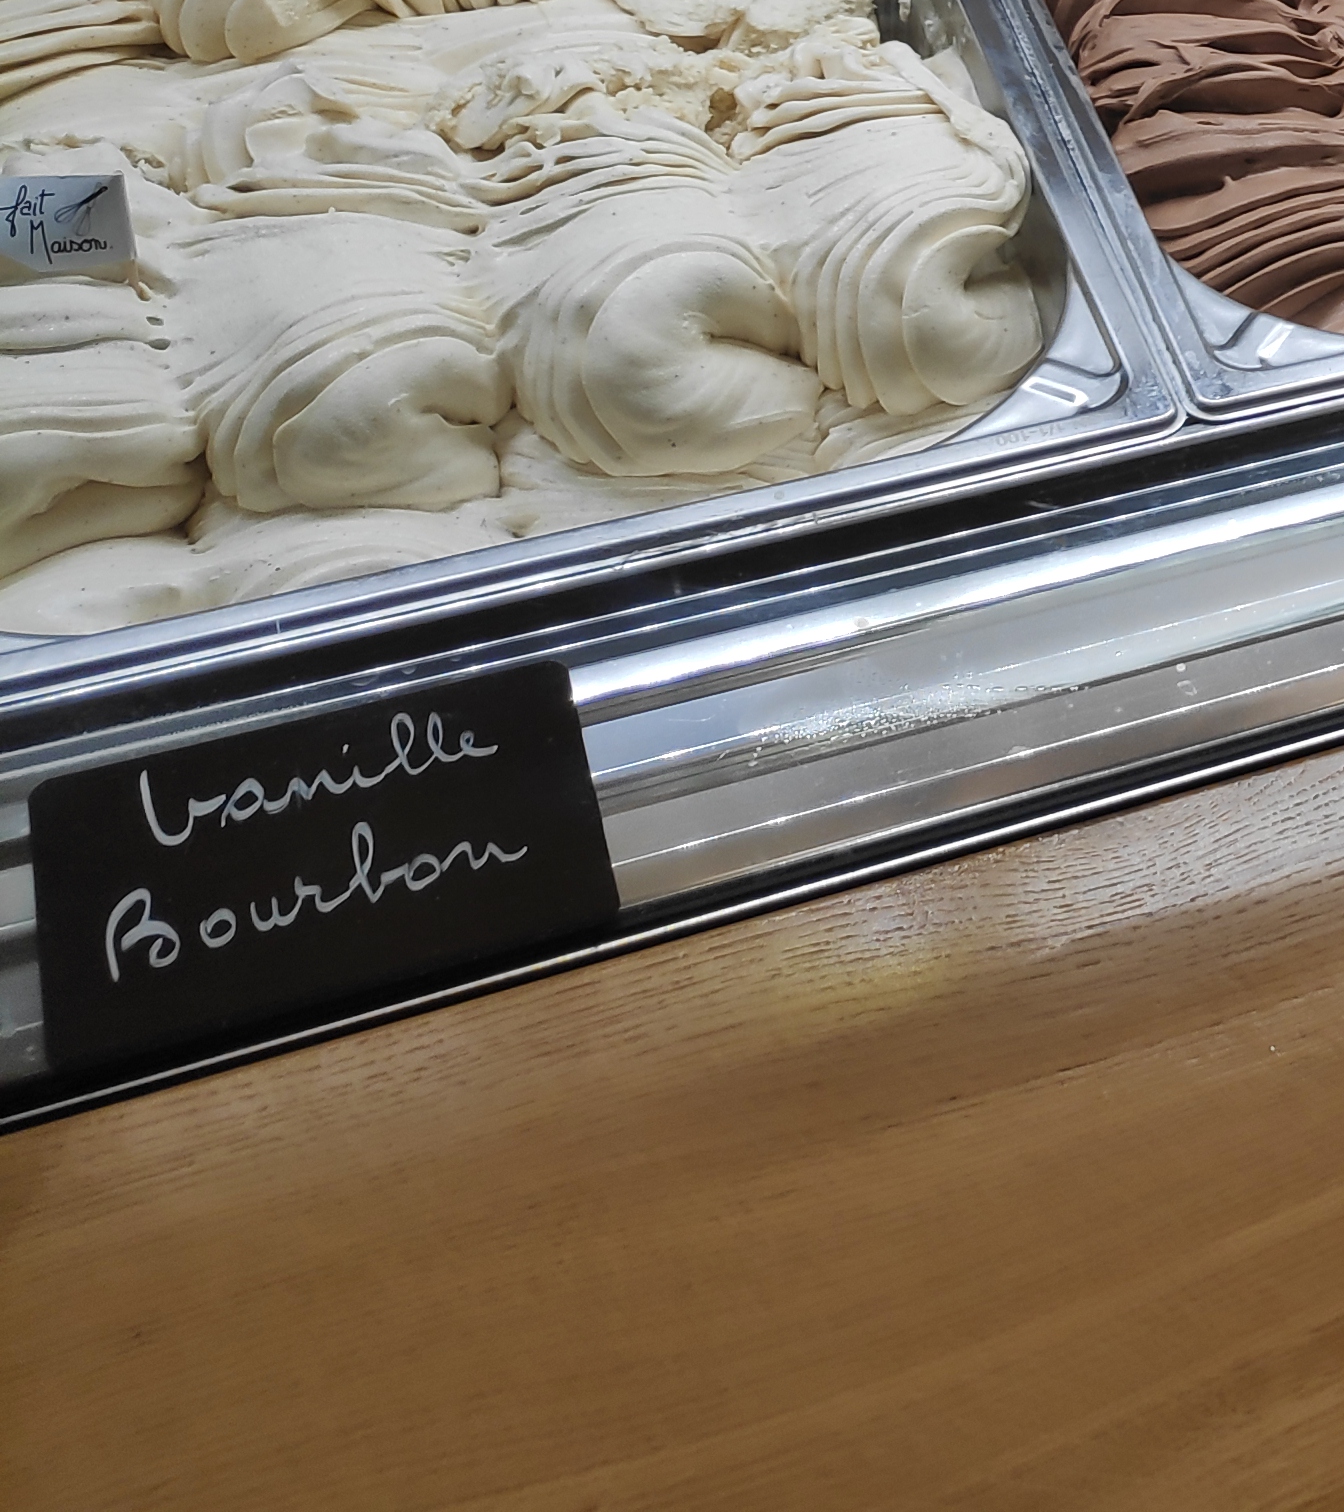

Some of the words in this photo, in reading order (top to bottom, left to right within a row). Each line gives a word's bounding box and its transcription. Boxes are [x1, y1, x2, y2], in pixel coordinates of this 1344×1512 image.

[0, 184, 56, 238] fait
[140, 711, 499, 846] Vanille
[106, 822, 528, 982] Bourbon
